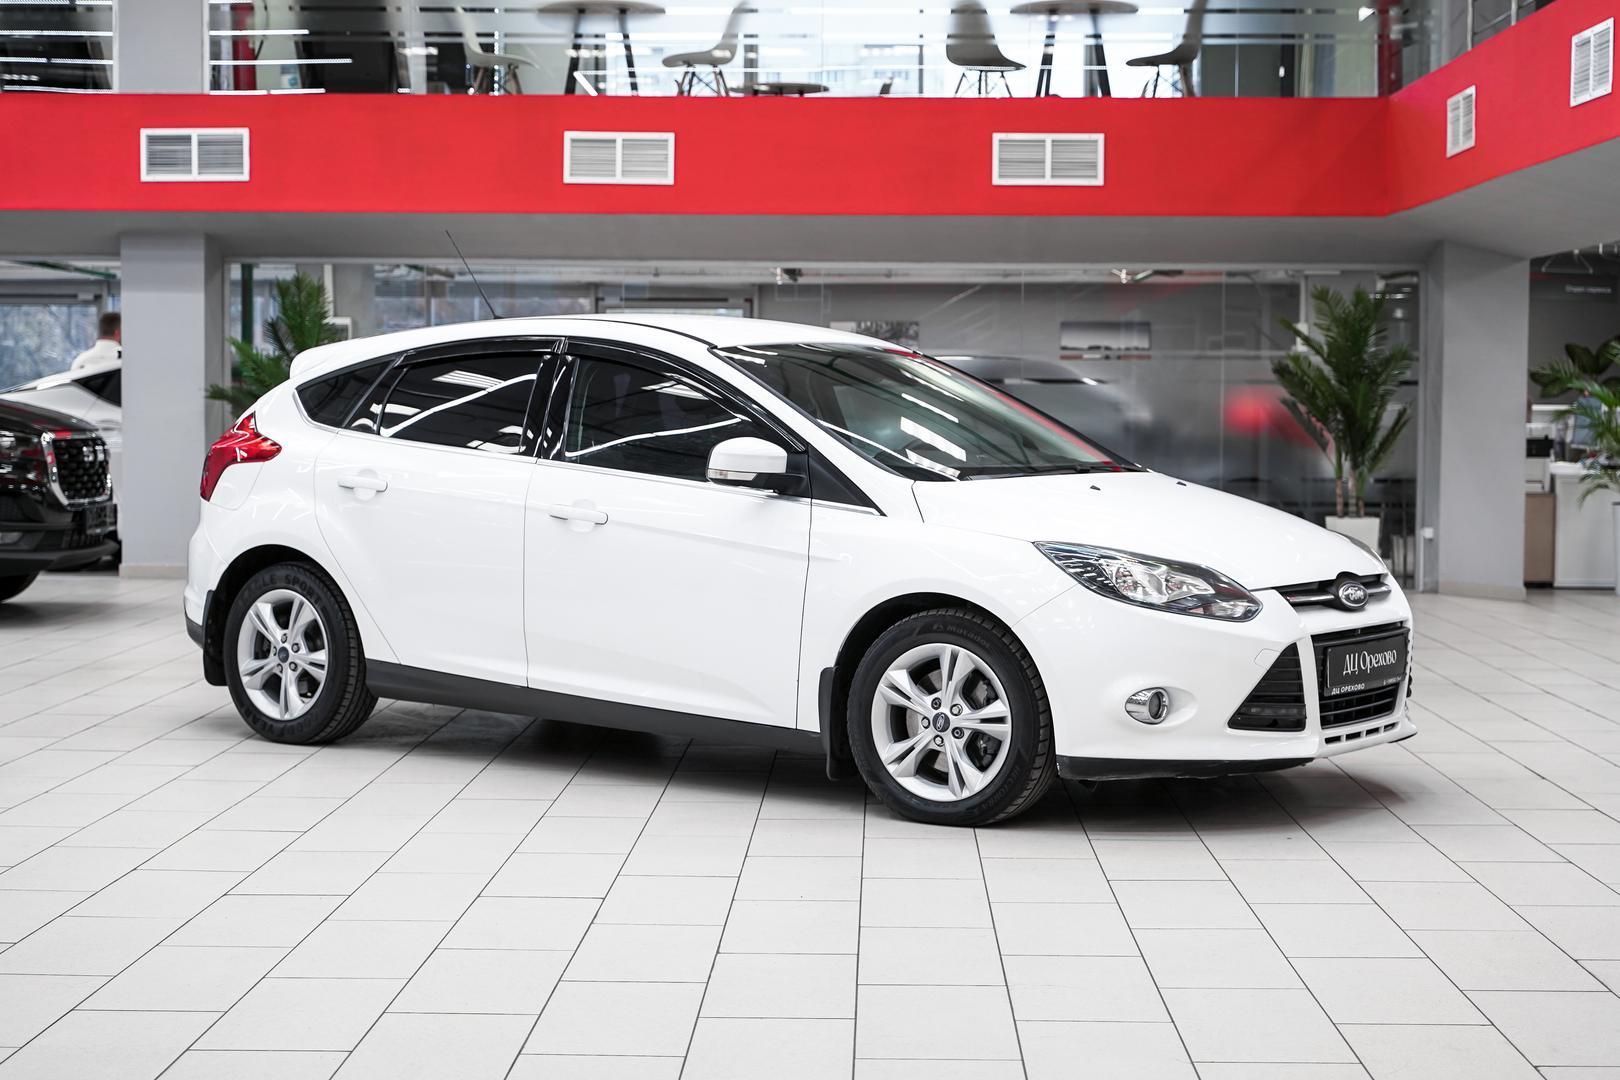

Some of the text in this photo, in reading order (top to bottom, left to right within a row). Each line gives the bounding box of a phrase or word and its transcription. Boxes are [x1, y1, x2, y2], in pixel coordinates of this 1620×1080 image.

[1343, 650, 1397, 676] ДЦ Орехово
[1340, 683, 1365, 693] ОРЕХОВО
